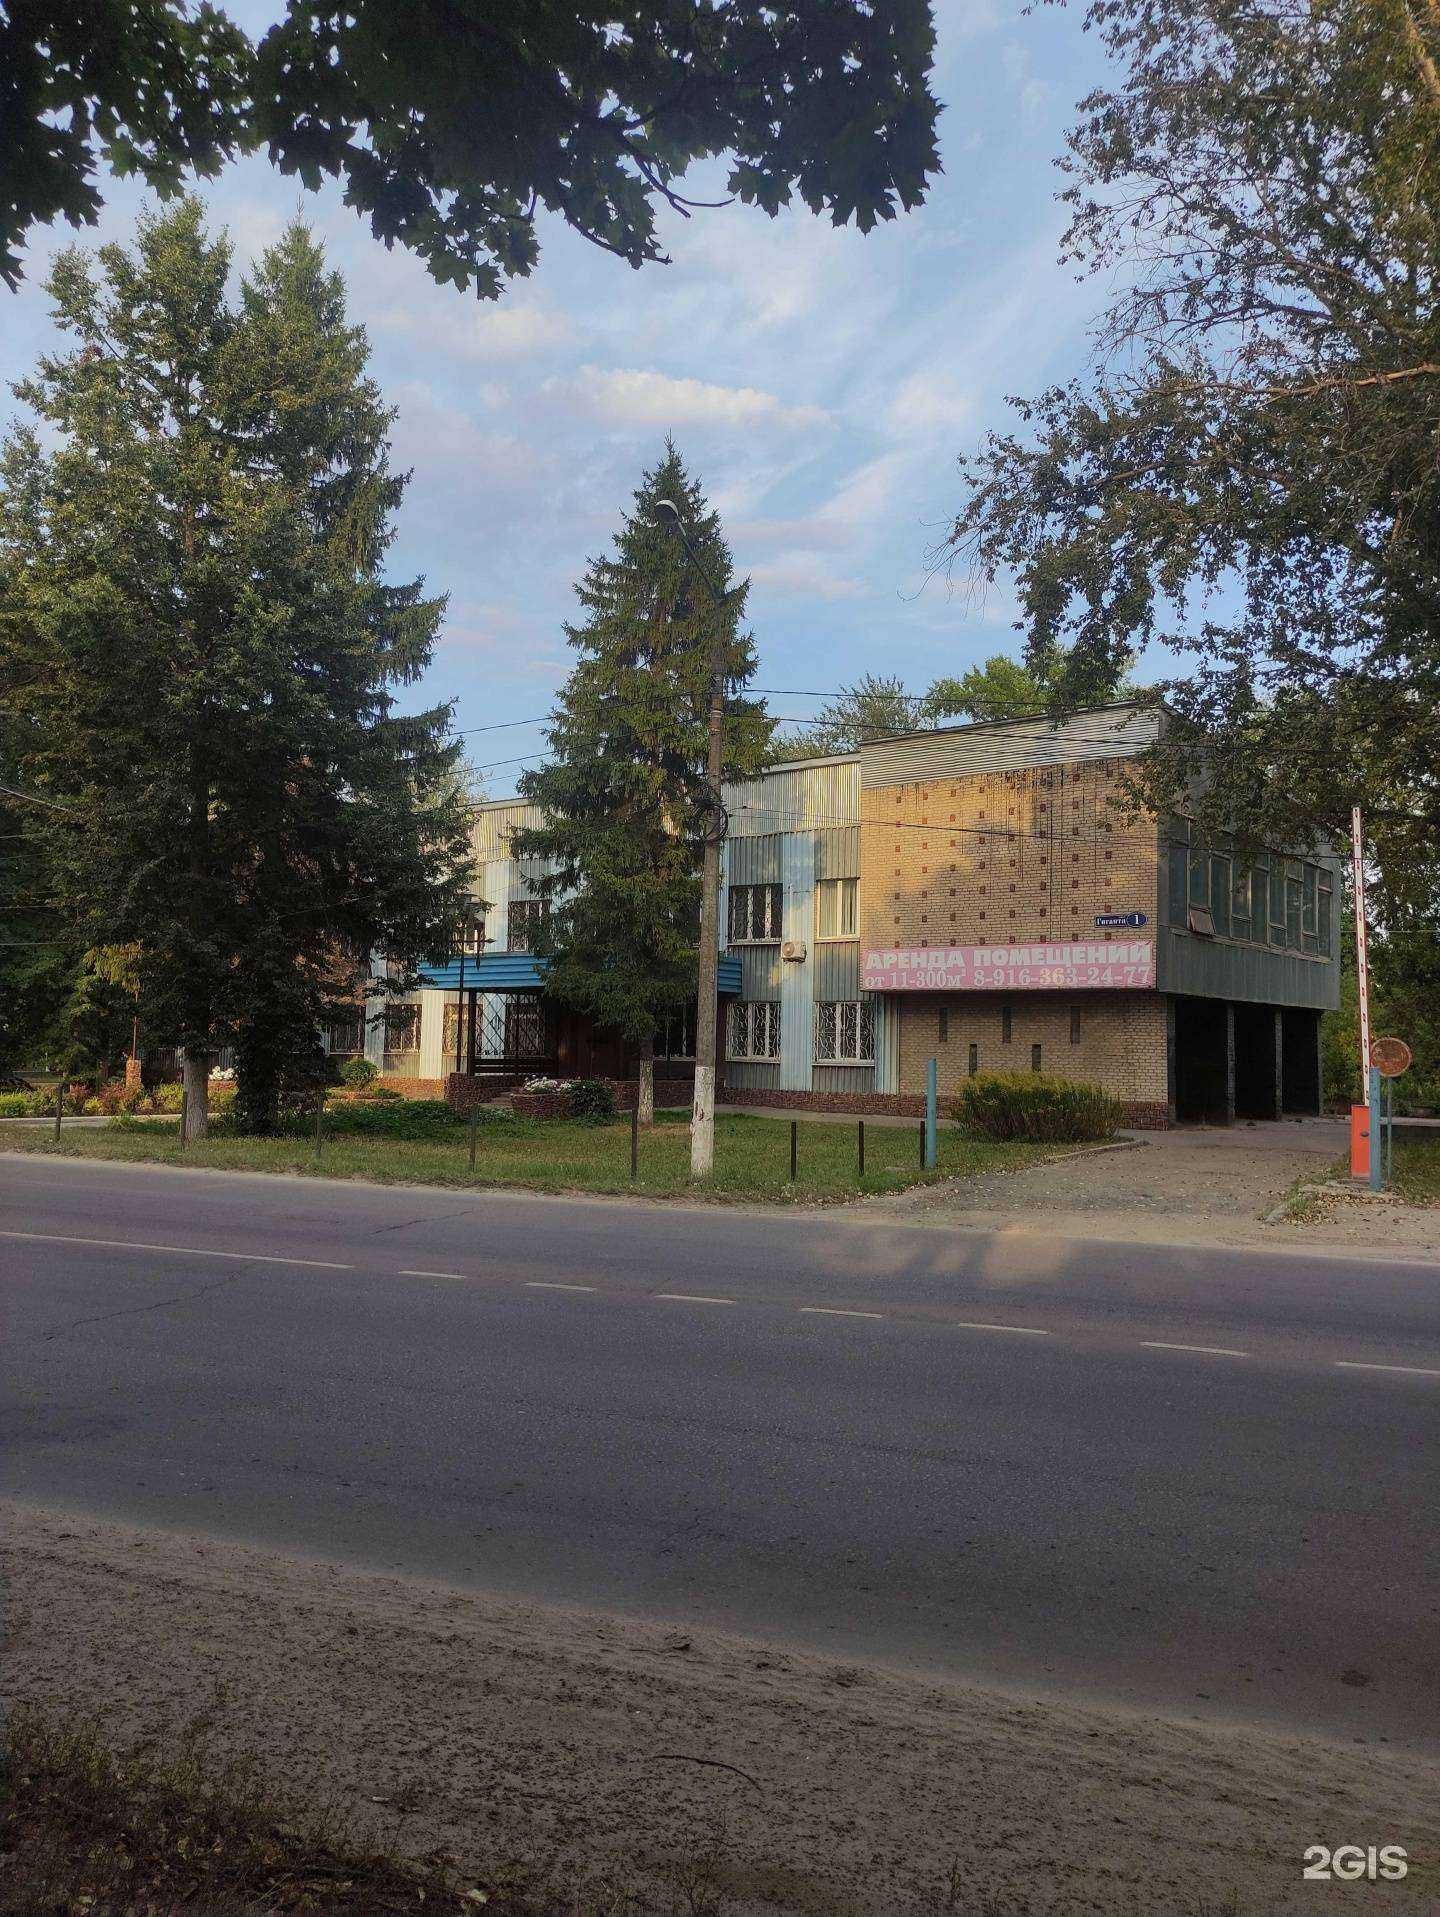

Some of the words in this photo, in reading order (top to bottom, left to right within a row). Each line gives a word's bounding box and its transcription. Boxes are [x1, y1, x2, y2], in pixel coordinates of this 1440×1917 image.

[866, 951, 965, 970] АРЕНДА
[973, 943, 1150, 967] ПОМЕЩЕНИЙ
[864, 976, 884, 988] от
[973, 966, 1151, 987] 8-916-363-24-77
